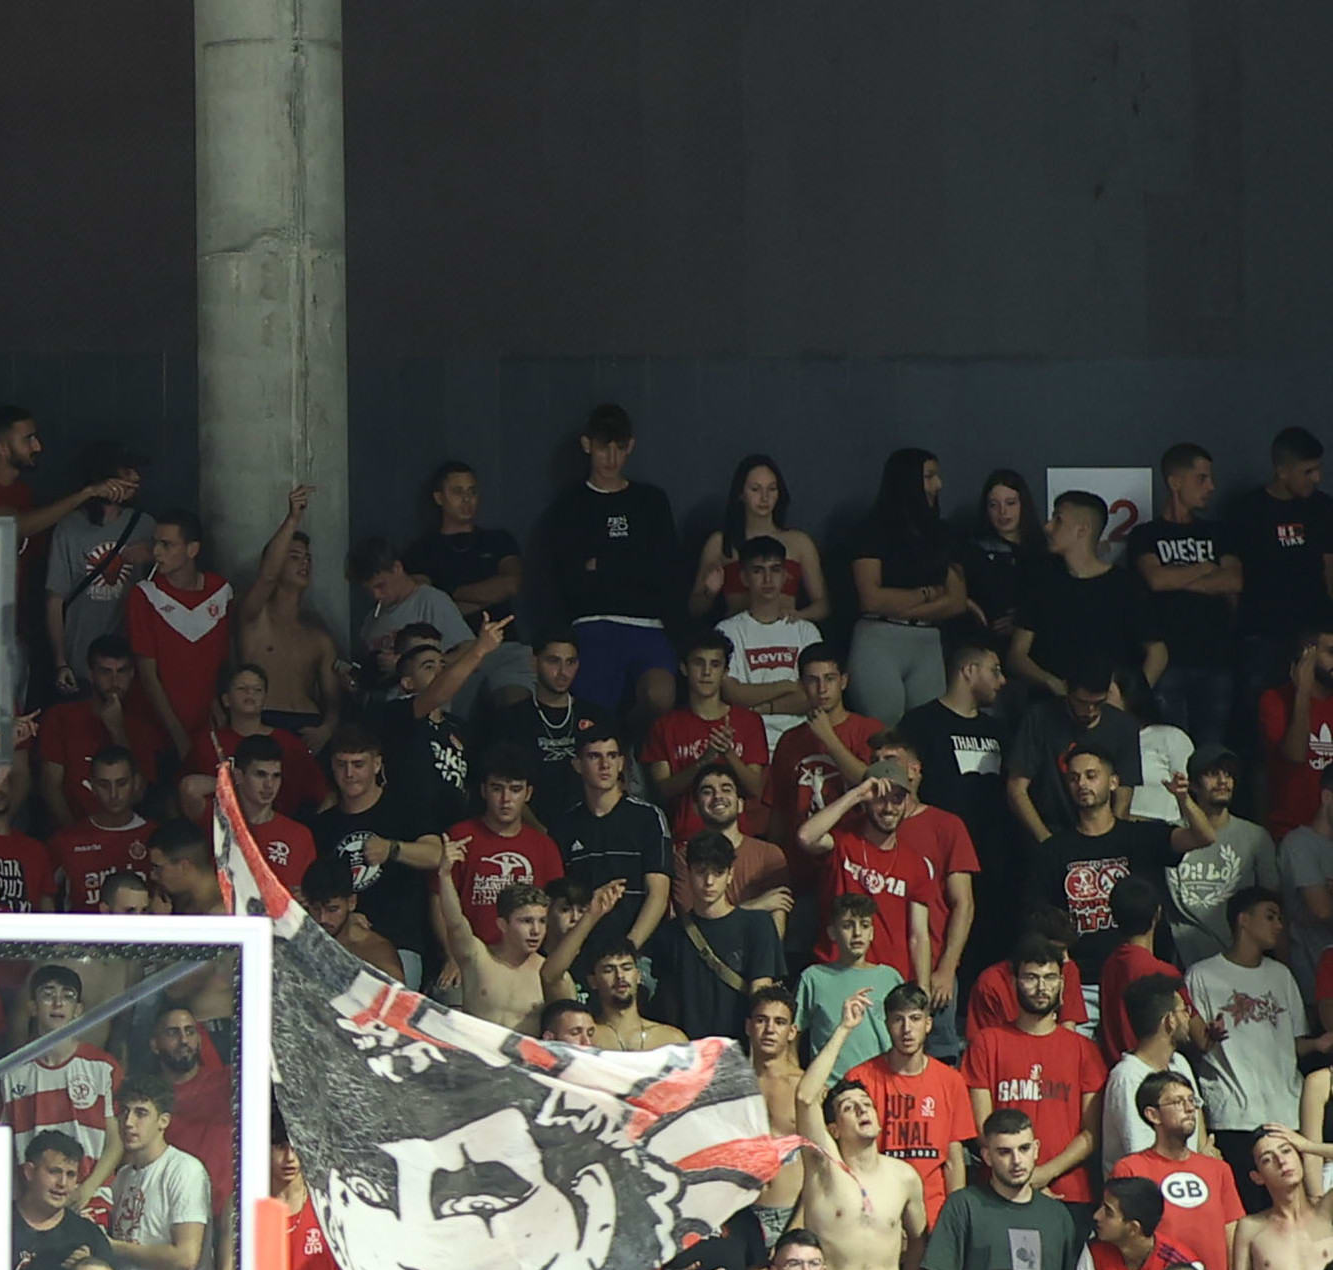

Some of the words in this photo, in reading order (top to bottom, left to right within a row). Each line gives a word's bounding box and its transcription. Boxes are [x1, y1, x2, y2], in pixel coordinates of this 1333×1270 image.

[1156, 537, 1216, 563] DIESEL
[885, 1094, 915, 1119] UP
[1167, 1180, 1203, 1198] GB
